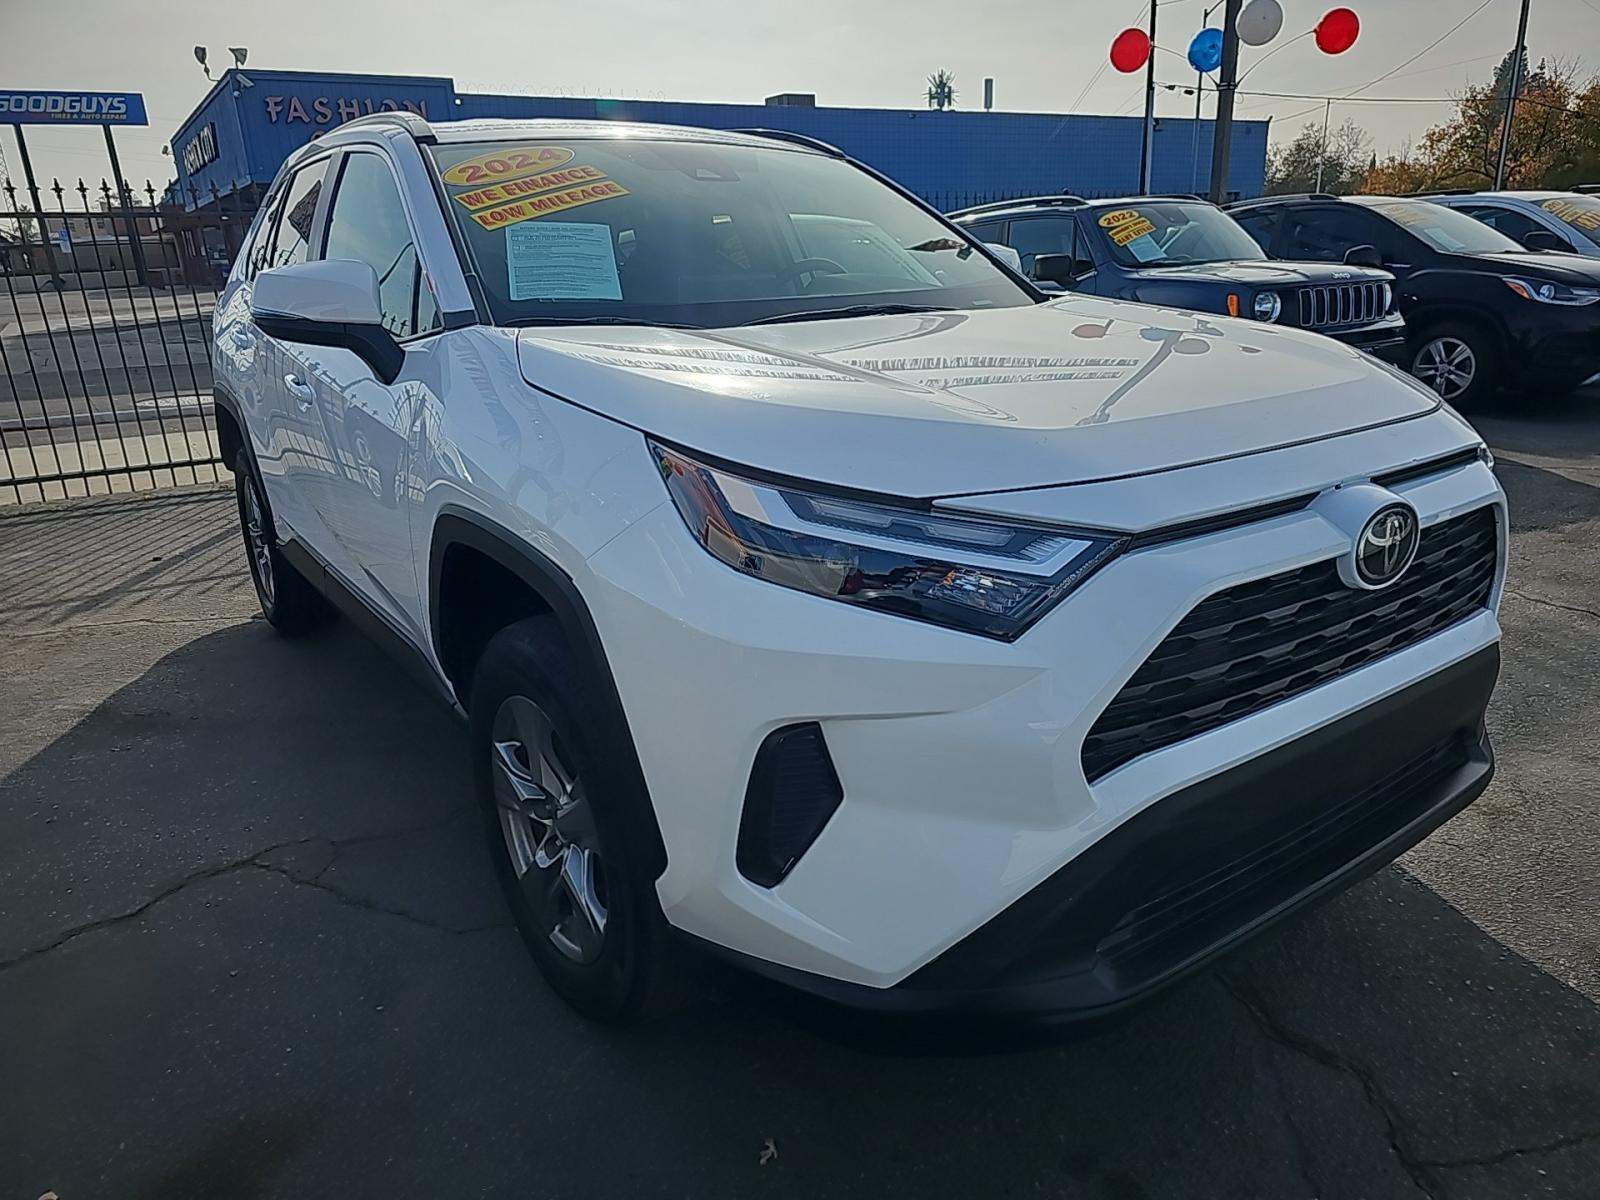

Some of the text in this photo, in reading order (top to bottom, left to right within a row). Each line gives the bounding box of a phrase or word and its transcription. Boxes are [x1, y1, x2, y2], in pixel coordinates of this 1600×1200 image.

[0, 95, 126, 113] GOODGUYS
[458, 148, 563, 184] 2024
[458, 166, 599, 207] WE FINANCE
[477, 182, 621, 227] LOW MILEAGE
[1104, 211, 1136, 226] 2022
